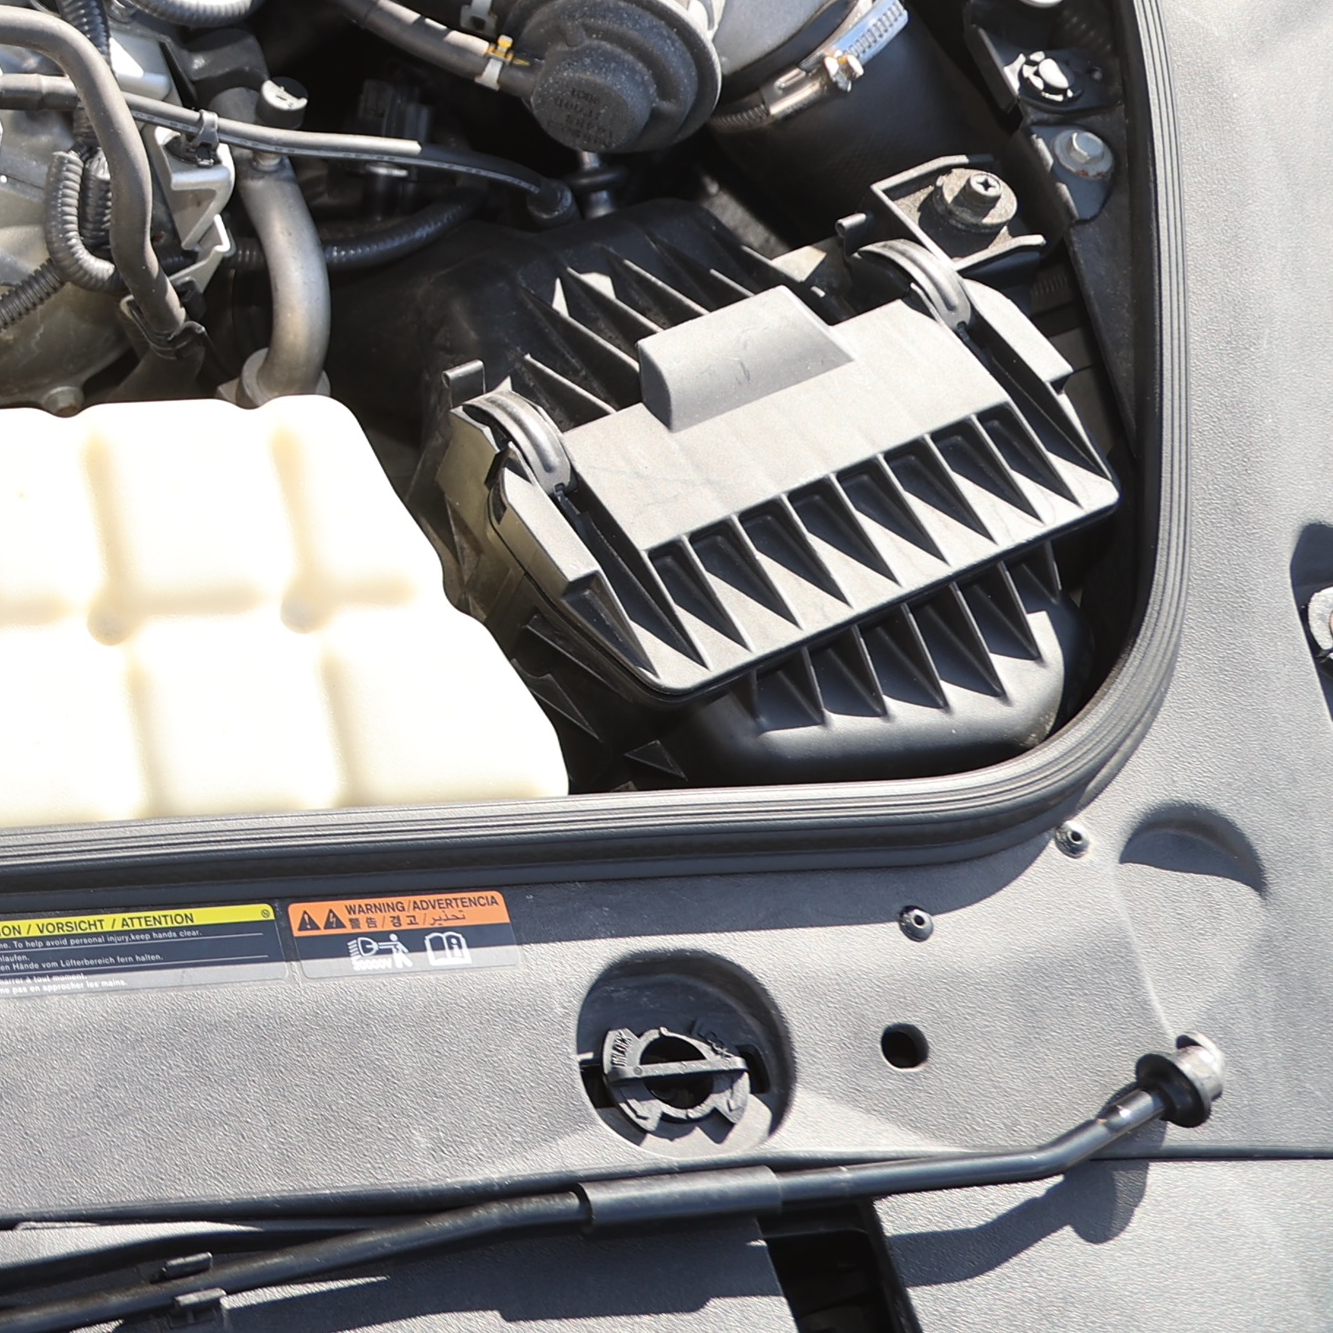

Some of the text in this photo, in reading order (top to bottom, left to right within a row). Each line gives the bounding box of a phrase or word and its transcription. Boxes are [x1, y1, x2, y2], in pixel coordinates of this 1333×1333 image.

[37, 919, 105, 934] VORSICHT
[120, 912, 195, 928] ATTENTION
[13, 940, 23, 948] To
[25, 938, 43, 949] help
[46, 937, 68, 946] avoid
[70, 935, 105, 947] personal
[152, 930, 177, 940] hands
[179, 928, 202, 937] clear.
[12, 961, 39, 971] Hände
[41, 961, 58, 969] vom
[60, 955, 115, 967] Lüfterbereich
[117, 954, 133, 963] fern
[136, 952, 163, 962] halten.
